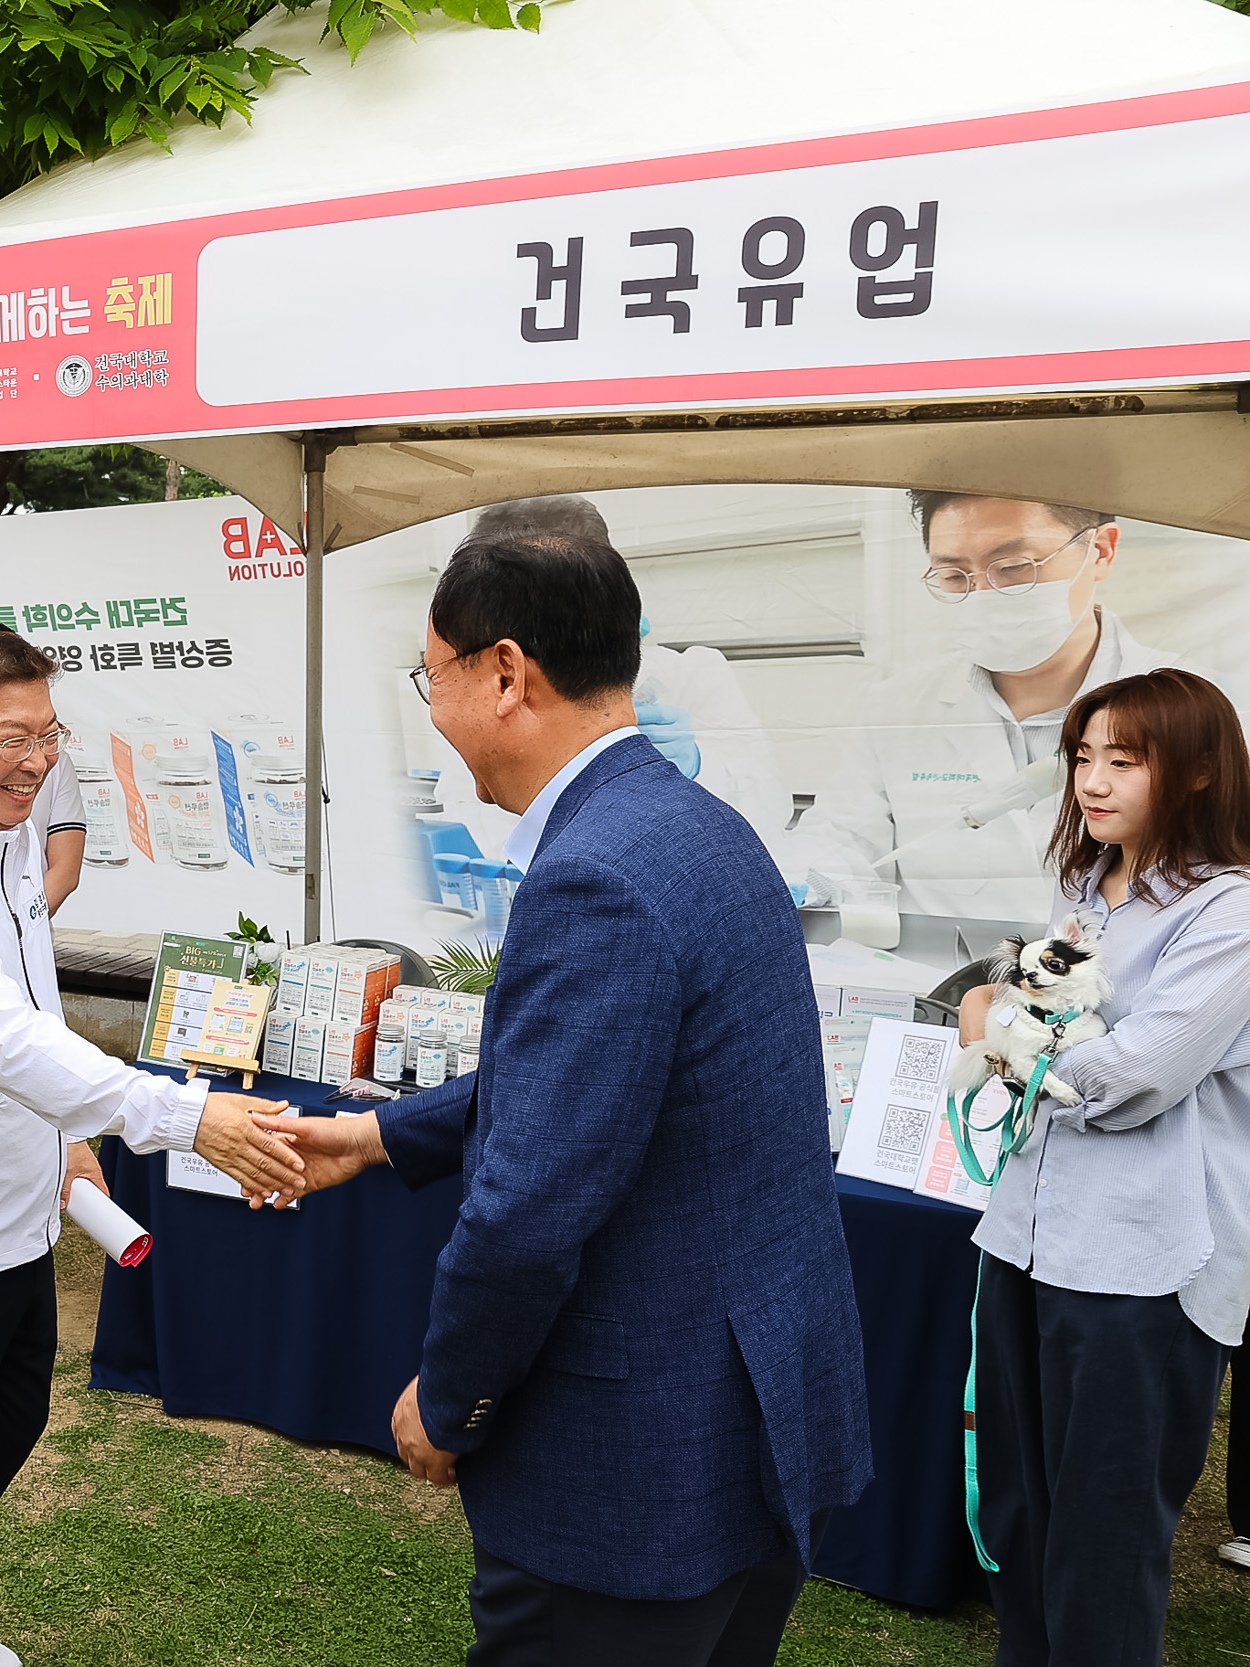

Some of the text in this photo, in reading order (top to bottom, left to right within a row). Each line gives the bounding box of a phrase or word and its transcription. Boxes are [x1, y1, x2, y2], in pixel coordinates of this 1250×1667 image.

[516, 200, 939, 343] 건국유업
[103, 272, 173, 330] 축제
[95, 350, 169, 371] 건국대학교
[95, 368, 169, 391] 수의과대학
[185, 945, 201, 956] BIG
[183, 1164, 219, 1177] 스마트스토어
